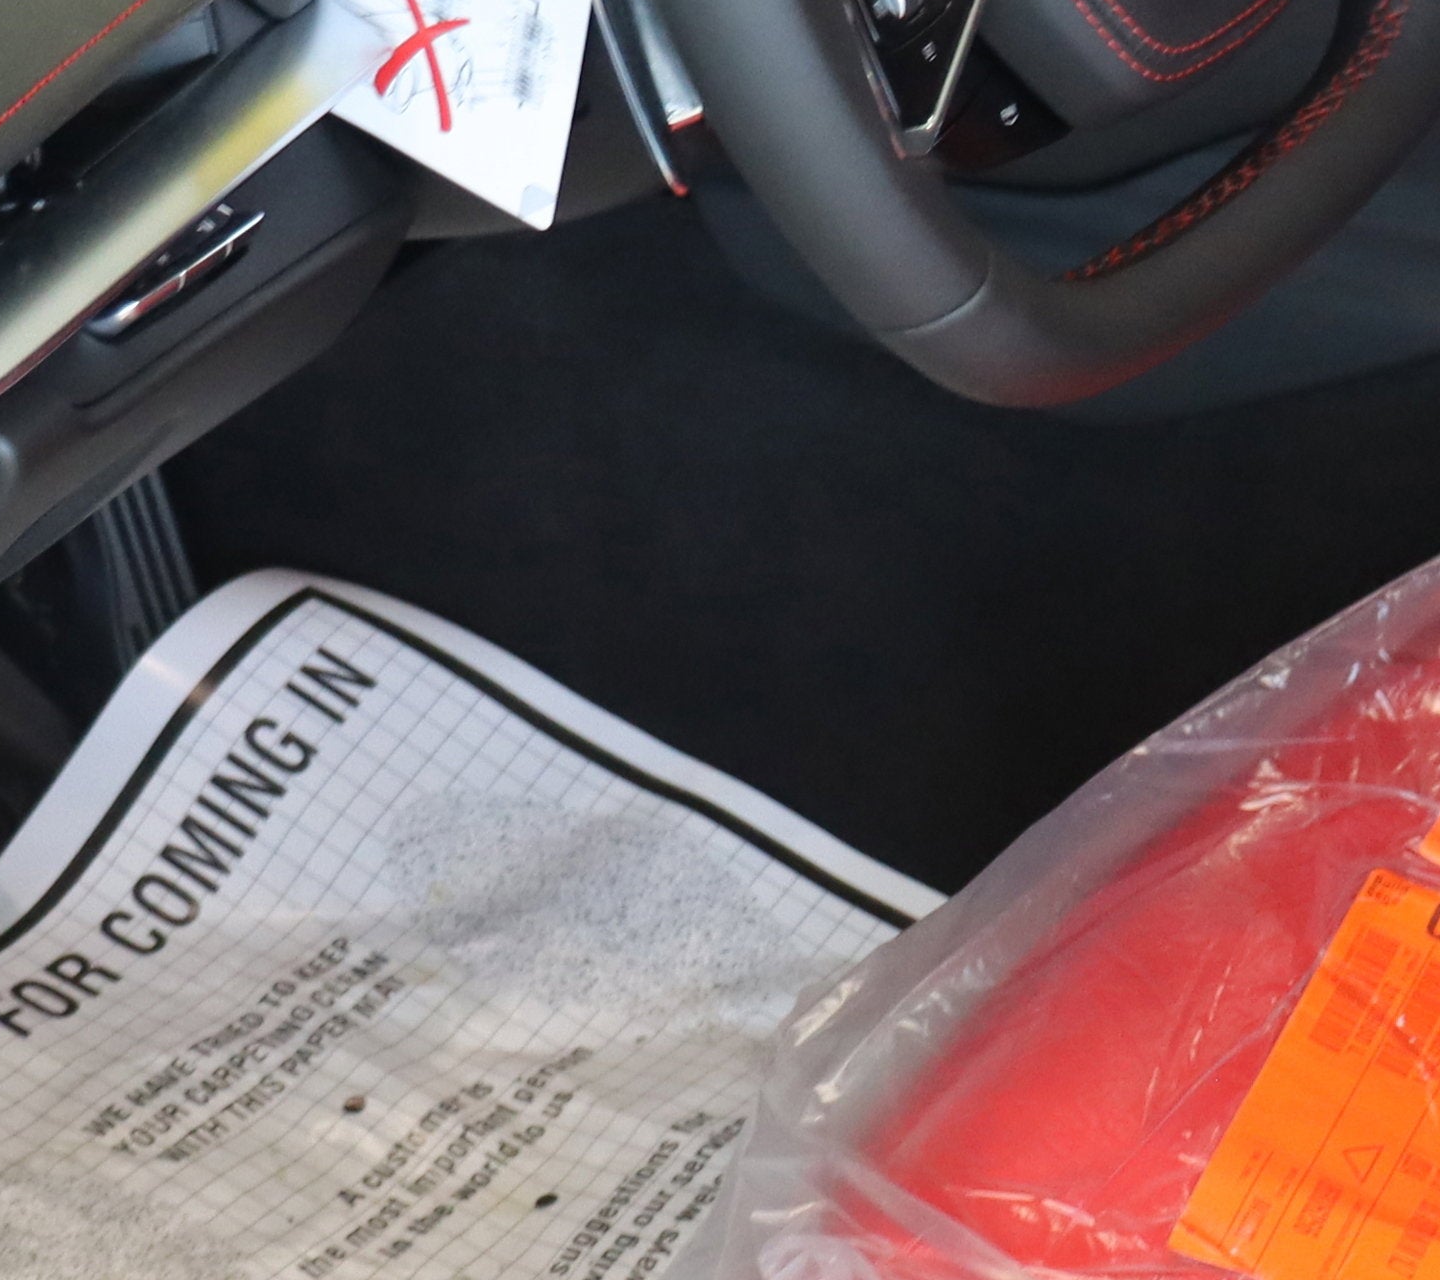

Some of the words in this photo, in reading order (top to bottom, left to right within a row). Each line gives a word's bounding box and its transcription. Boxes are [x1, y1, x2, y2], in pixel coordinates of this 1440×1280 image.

[99, 716, 318, 957] COMING
[286, 647, 378, 723] IN
[83, 1103, 132, 1138] WE
[125, 1056, 196, 1108] HAVE
[189, 1011, 264, 1057] TRIED
[259, 979, 297, 1009] TO
[293, 936, 351, 982] KEEP
[112, 1102, 189, 1156] YOUR
[183, 1005, 315, 1108] CARPETING
[310, 950, 389, 1010] CLEAN
[159, 1116, 231, 1163] WITH
[221, 1073, 287, 1123] THIS
[280, 1011, 359, 1078] PAPER
[351, 974, 406, 1020] MAT
[299, 1245, 347, 1280] the
[345, 1196, 411, 1248] most
[398, 1103, 520, 1197] important
[336, 1189, 367, 1208] A
[361, 1095, 465, 1191] customer
[450, 1140, 521, 1202] world
[513, 1123, 547, 1147] to
[550, 1139, 681, 1277] suggestions
[632, 1188, 675, 1229] our
